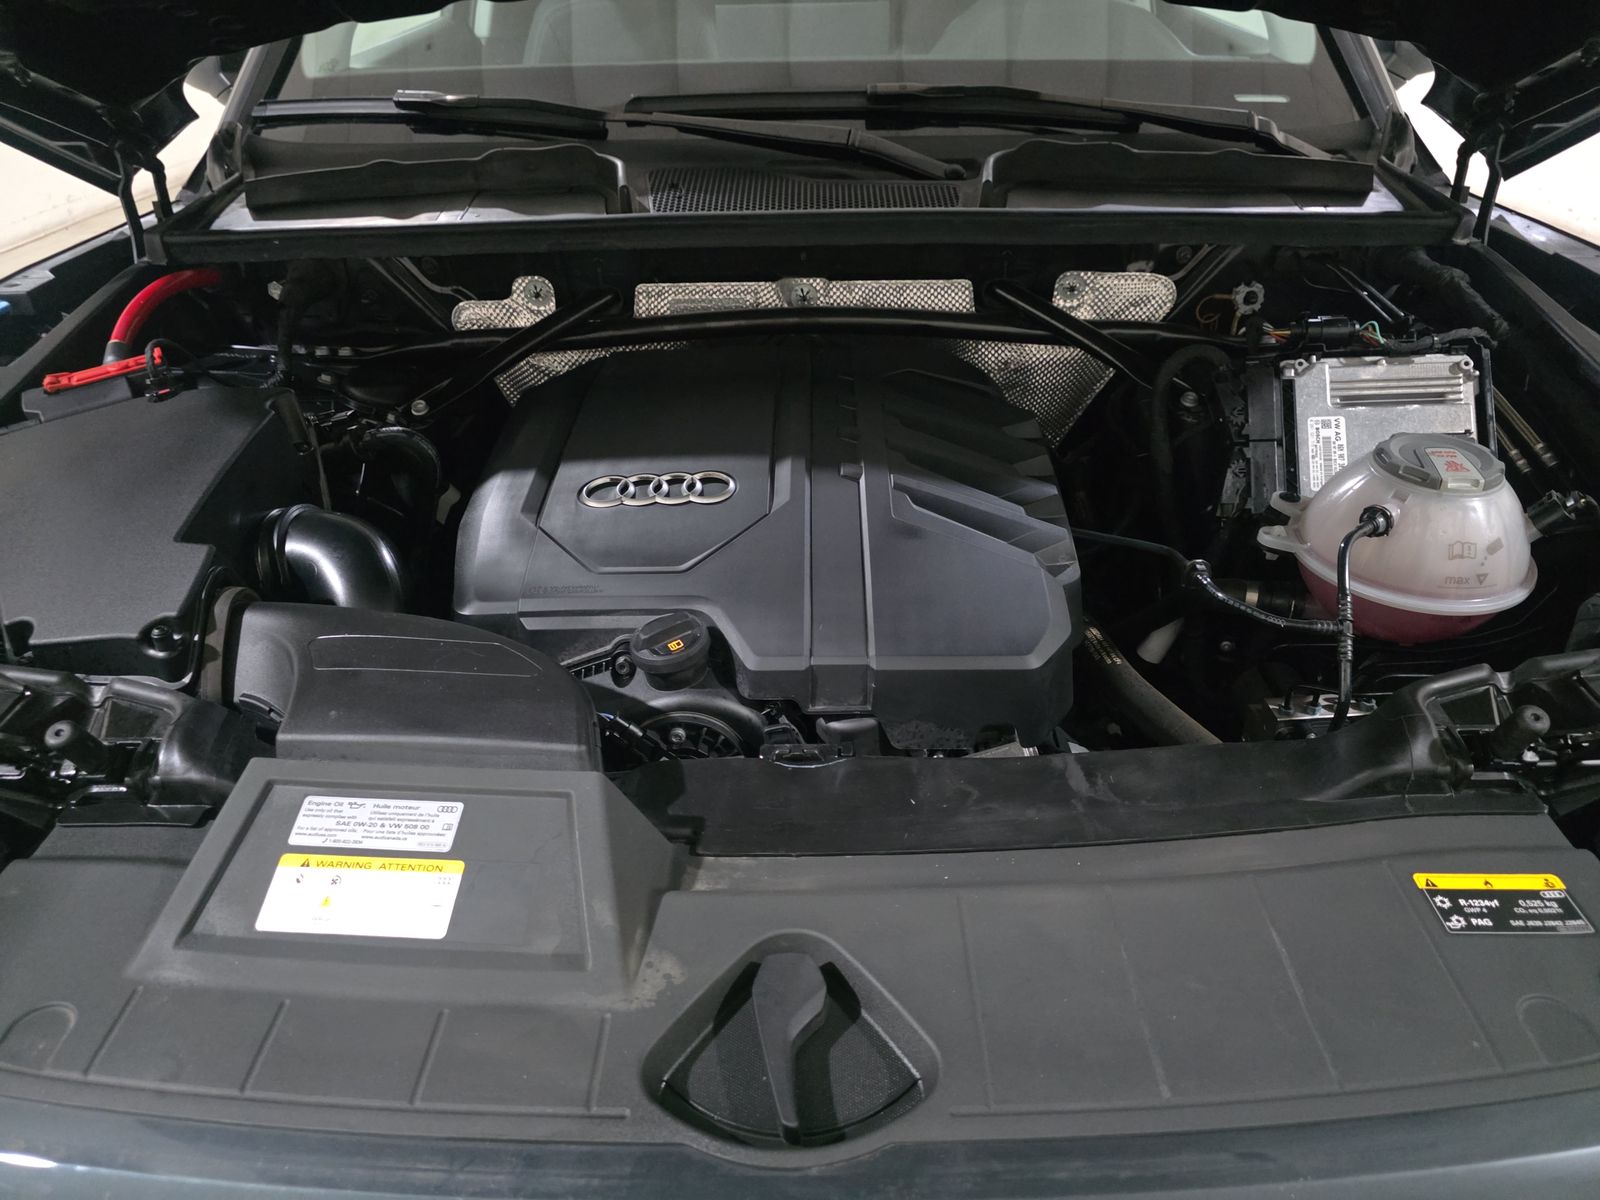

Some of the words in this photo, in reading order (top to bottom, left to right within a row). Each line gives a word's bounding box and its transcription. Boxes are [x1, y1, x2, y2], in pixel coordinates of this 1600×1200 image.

[1334, 418, 1341, 429] VW
[1335, 431, 1341, 441] AG
[1445, 576, 1470, 584] max
[316, 860, 372, 870] WARNING
[379, 862, 444, 873] ATTENTION
[1544, 900, 1559, 909] kg
[1470, 918, 1493, 926] PAG
